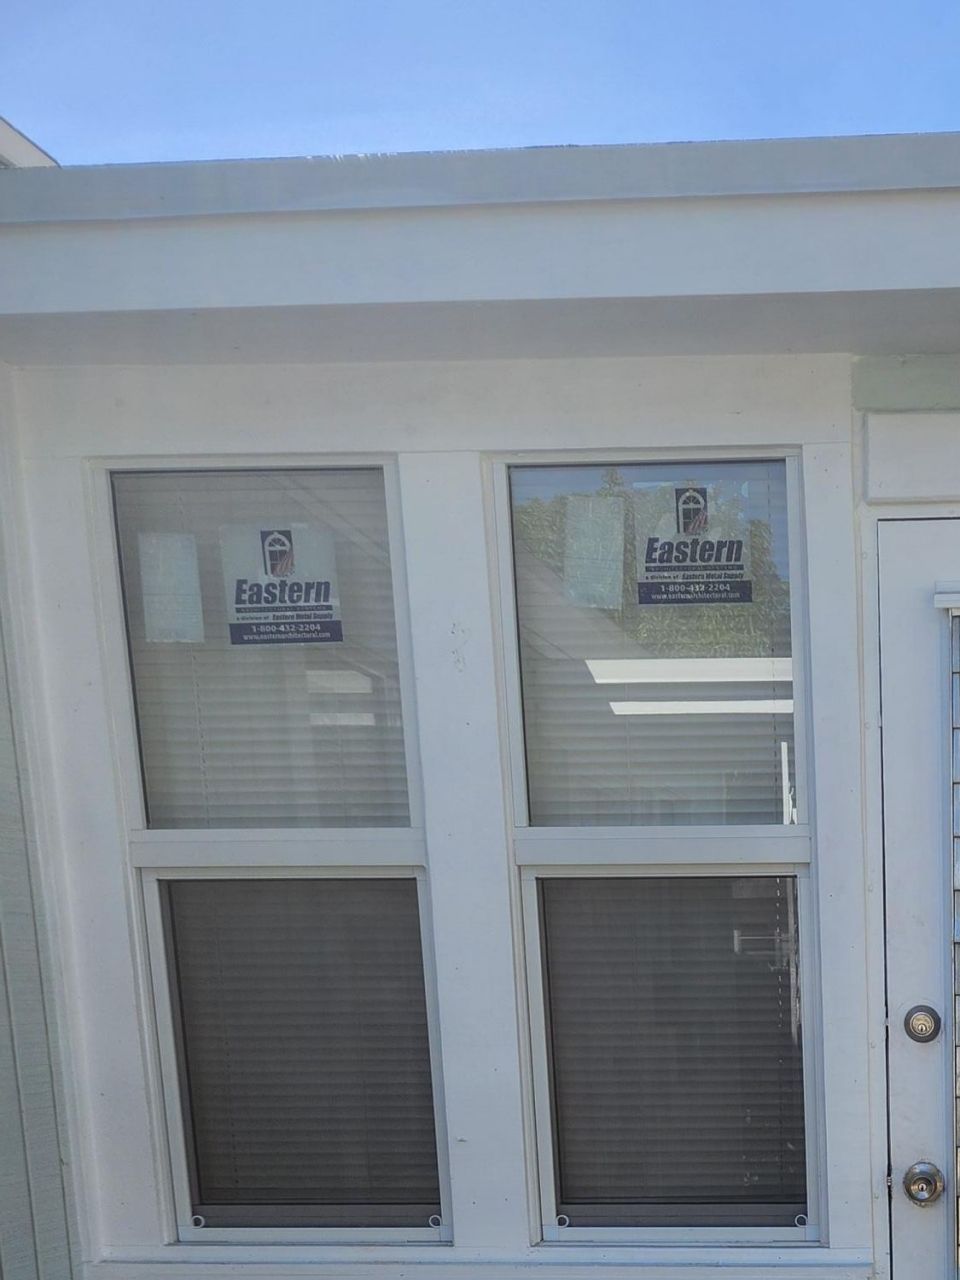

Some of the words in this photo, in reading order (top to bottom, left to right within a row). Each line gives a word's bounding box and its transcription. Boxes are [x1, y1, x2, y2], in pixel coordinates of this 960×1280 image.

[645, 537, 743, 564] Eastern
[235, 579, 331, 605] Eastern
[660, 583, 731, 592] 1-800-432-2204
[251, 623, 321, 633] 1-800-432-2204
